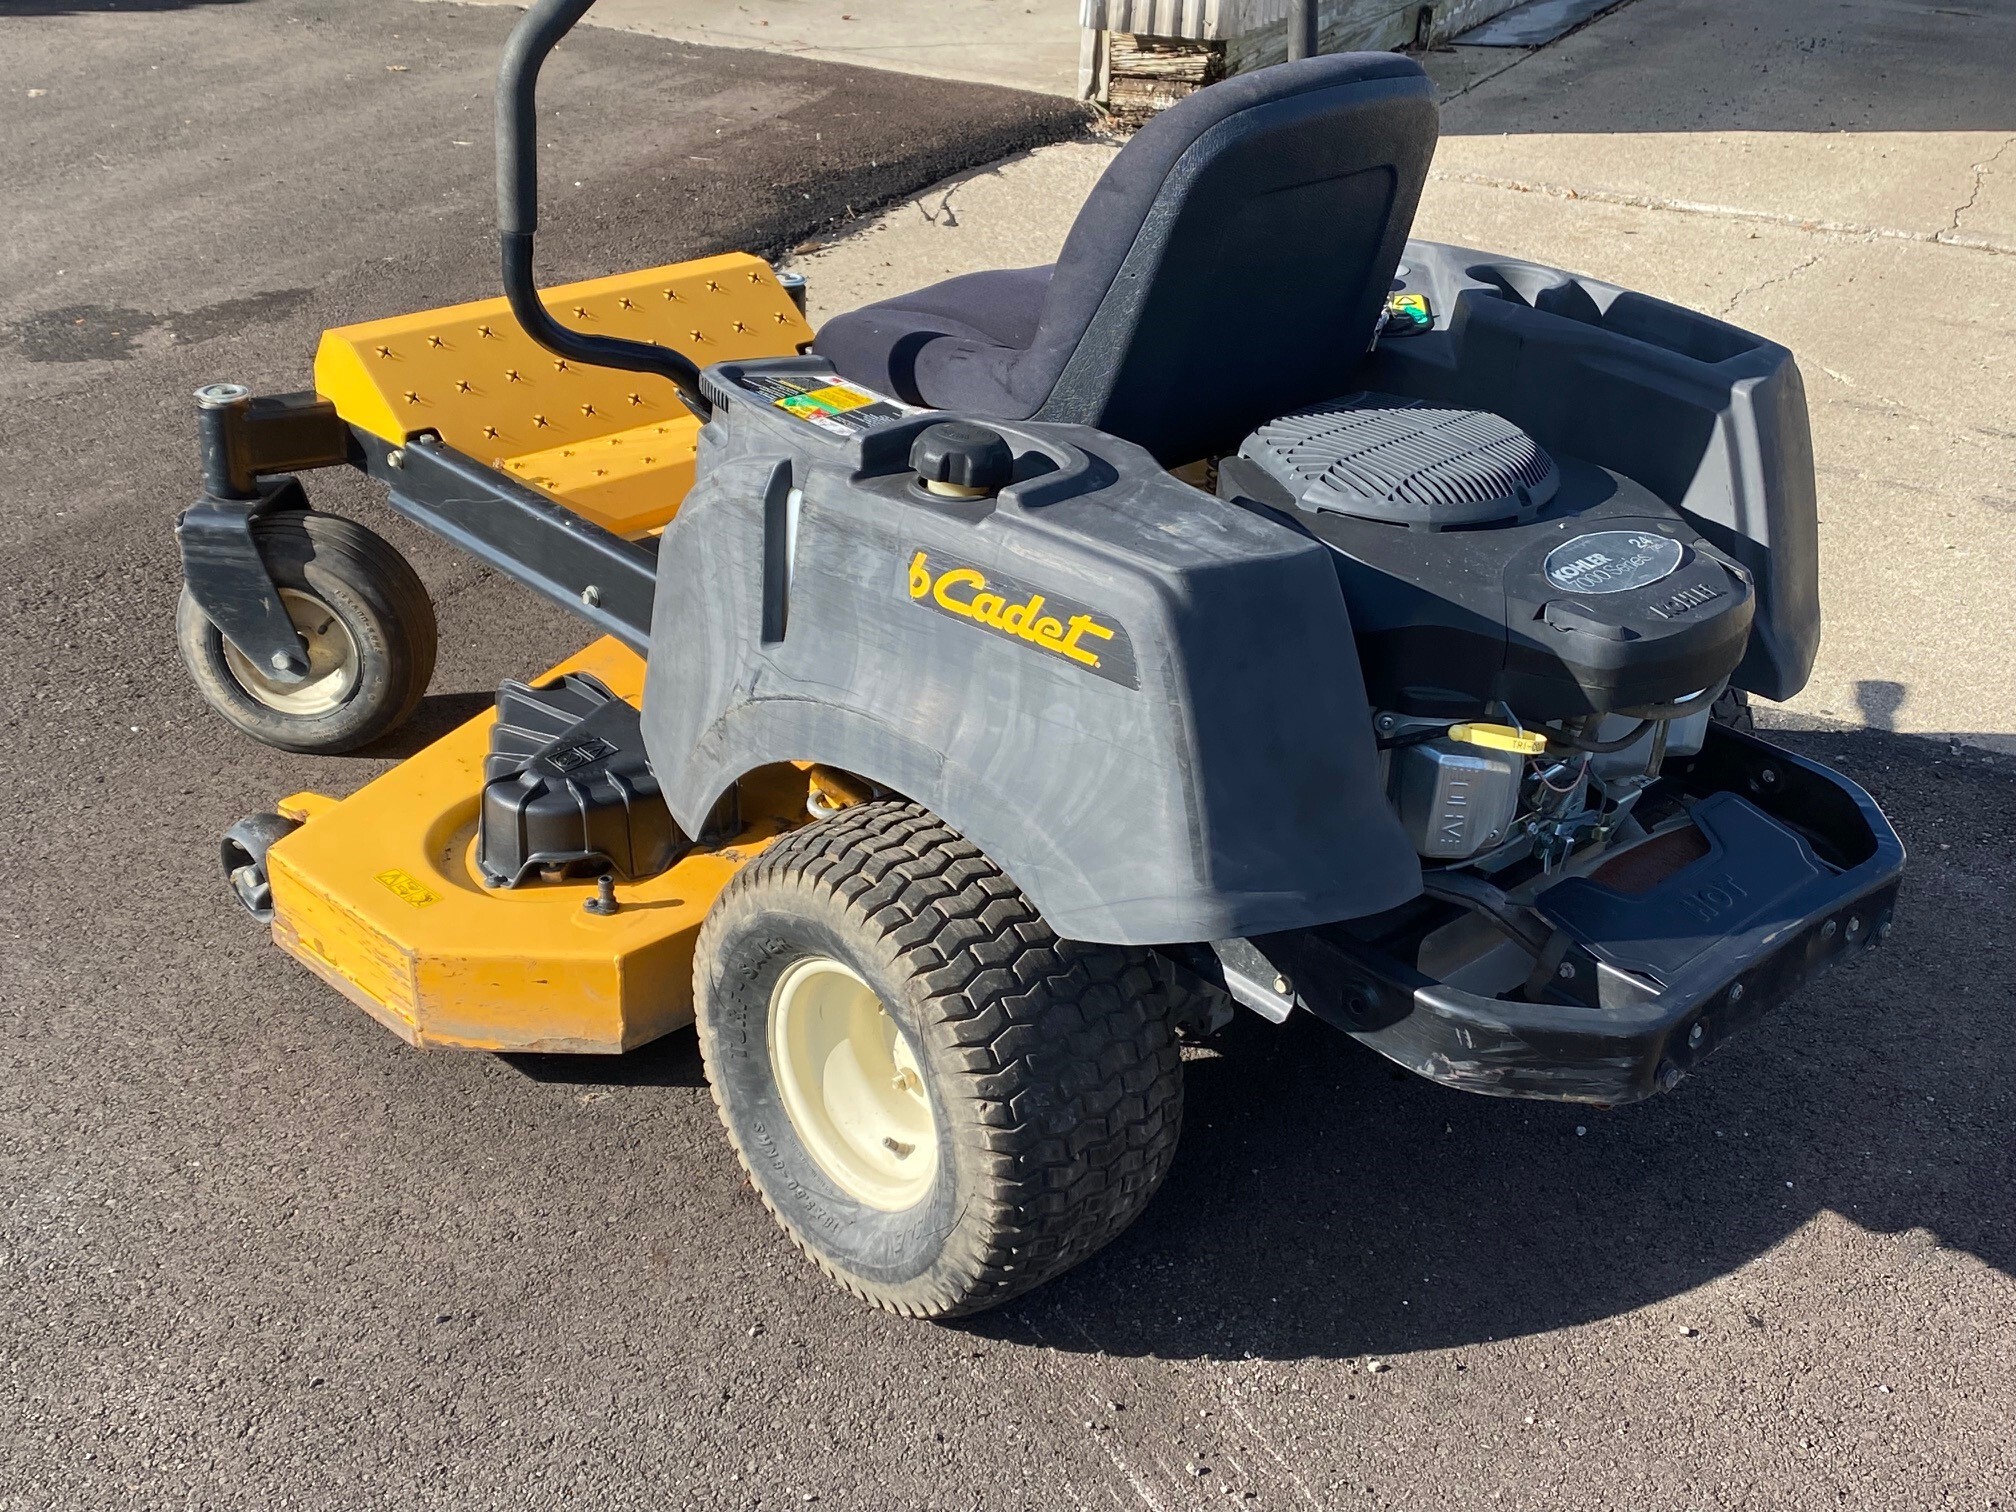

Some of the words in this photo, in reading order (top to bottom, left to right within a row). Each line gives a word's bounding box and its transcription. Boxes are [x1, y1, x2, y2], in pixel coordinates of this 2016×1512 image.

[1551, 553, 1613, 581] KOHLER
[1566, 569, 1612, 592] 7000
[1603, 553, 1653, 575] Series
[933, 568, 1115, 666] Cadet
[1680, 872, 1748, 922] HOT
